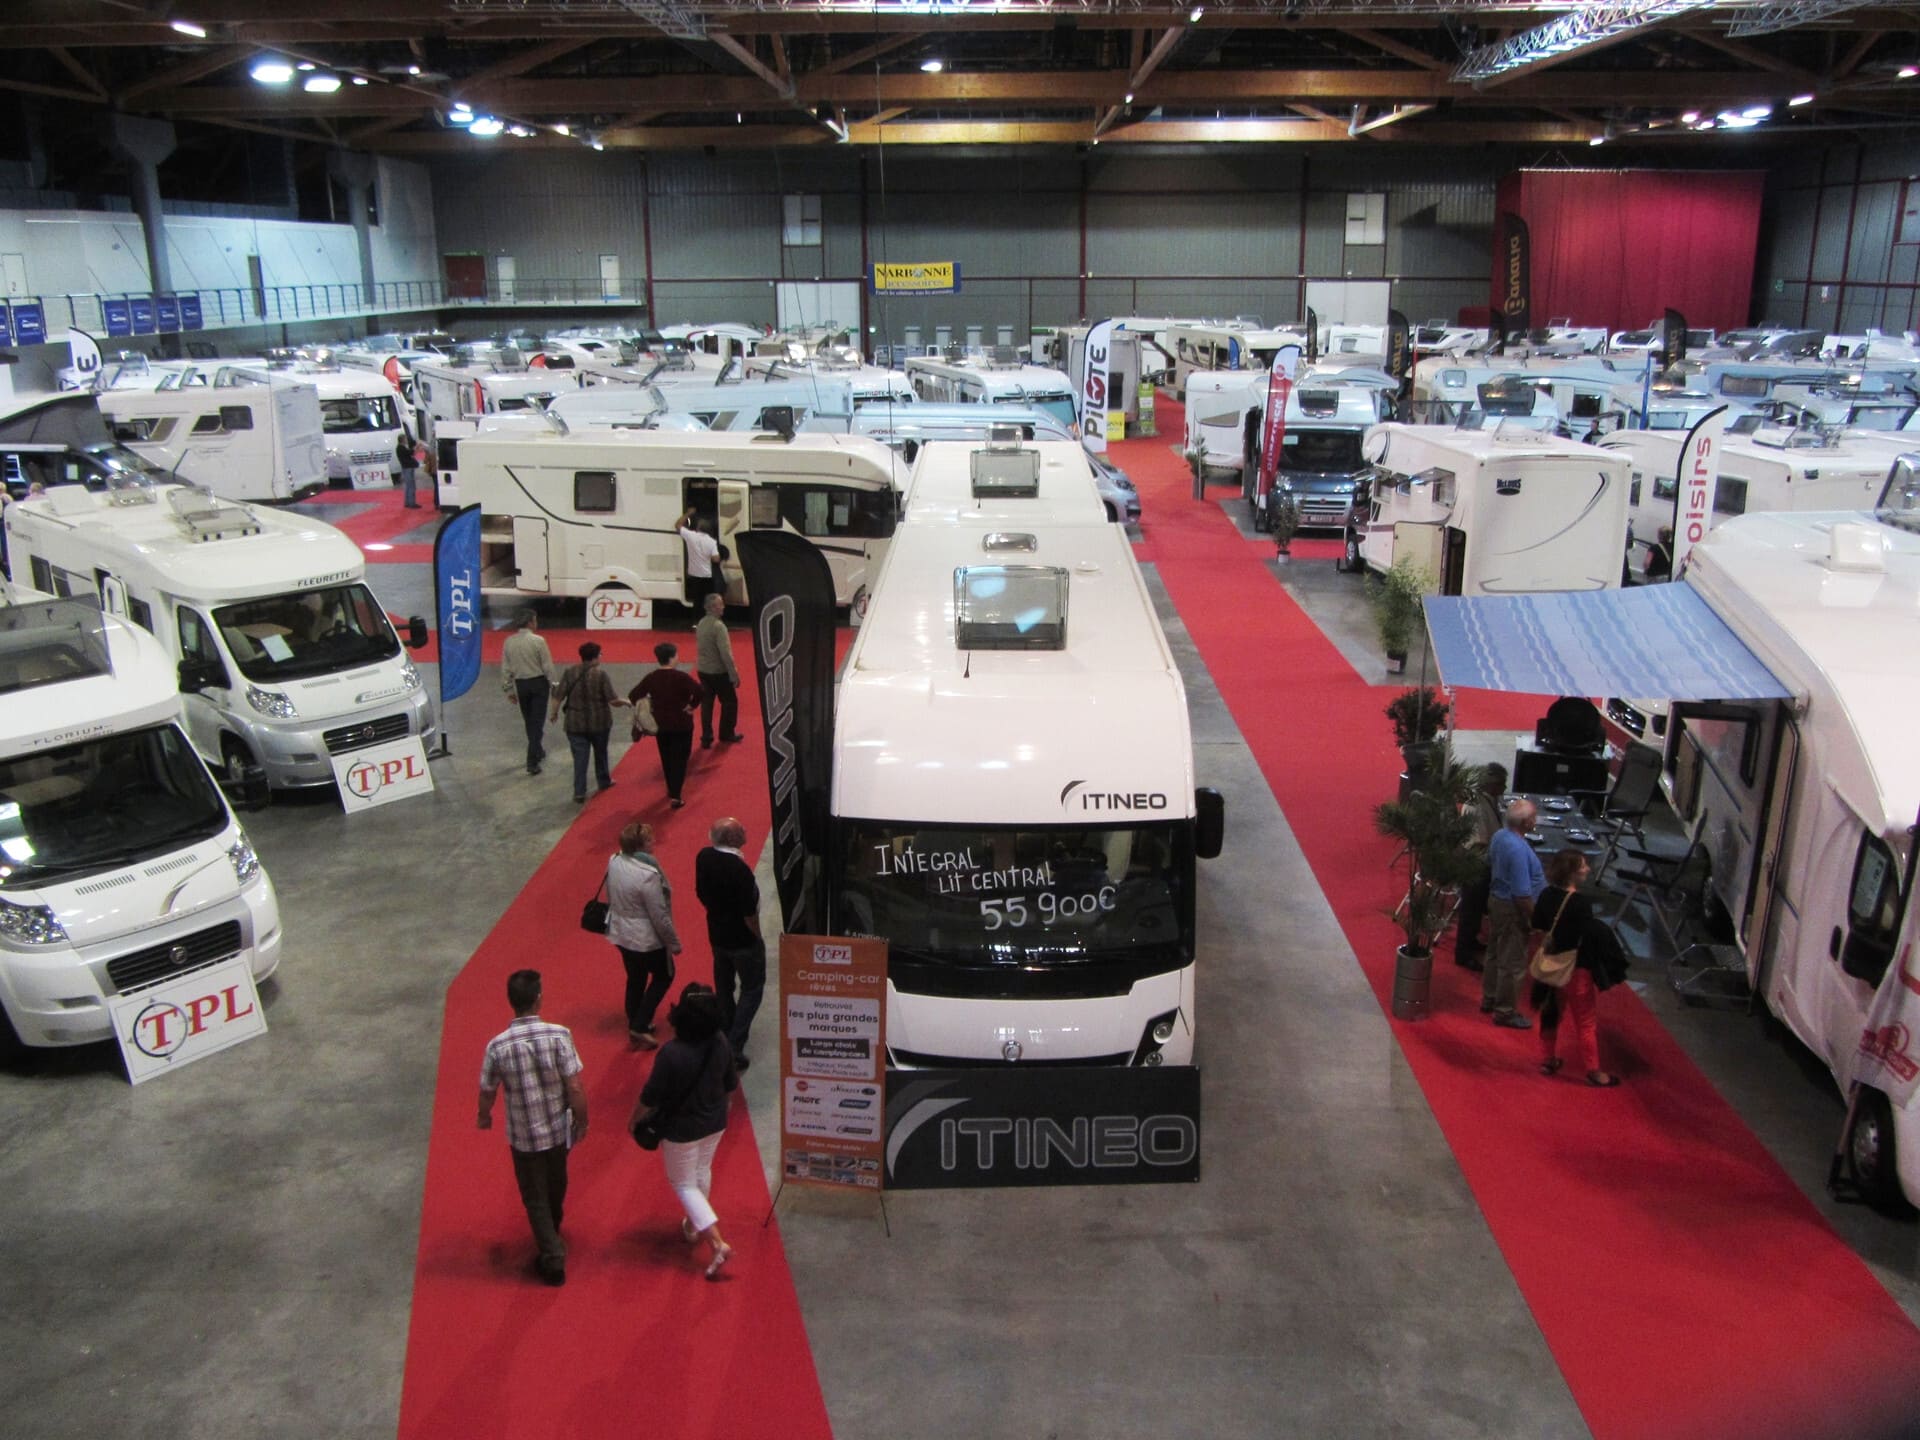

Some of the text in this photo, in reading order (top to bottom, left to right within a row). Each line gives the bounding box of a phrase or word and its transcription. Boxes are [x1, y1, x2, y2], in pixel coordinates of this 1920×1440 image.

[358, 470, 389, 482] TPL
[297, 570, 352, 587] FLEURETTE
[451, 569, 472, 634] TPL
[597, 601, 648, 618] TPL
[352, 755, 424, 793] TPL
[1082, 793, 1167, 810] ITINEO
[980, 896, 1027, 931] 55
[819, 948, 850, 960] TPL
[797, 970, 880, 984] Camping-car
[142, 985, 253, 1050] TPL
[789, 1009, 878, 1023] les plus grandes
[809, 1023, 858, 1034] marques
[941, 1115, 1197, 1170] ITINEO
